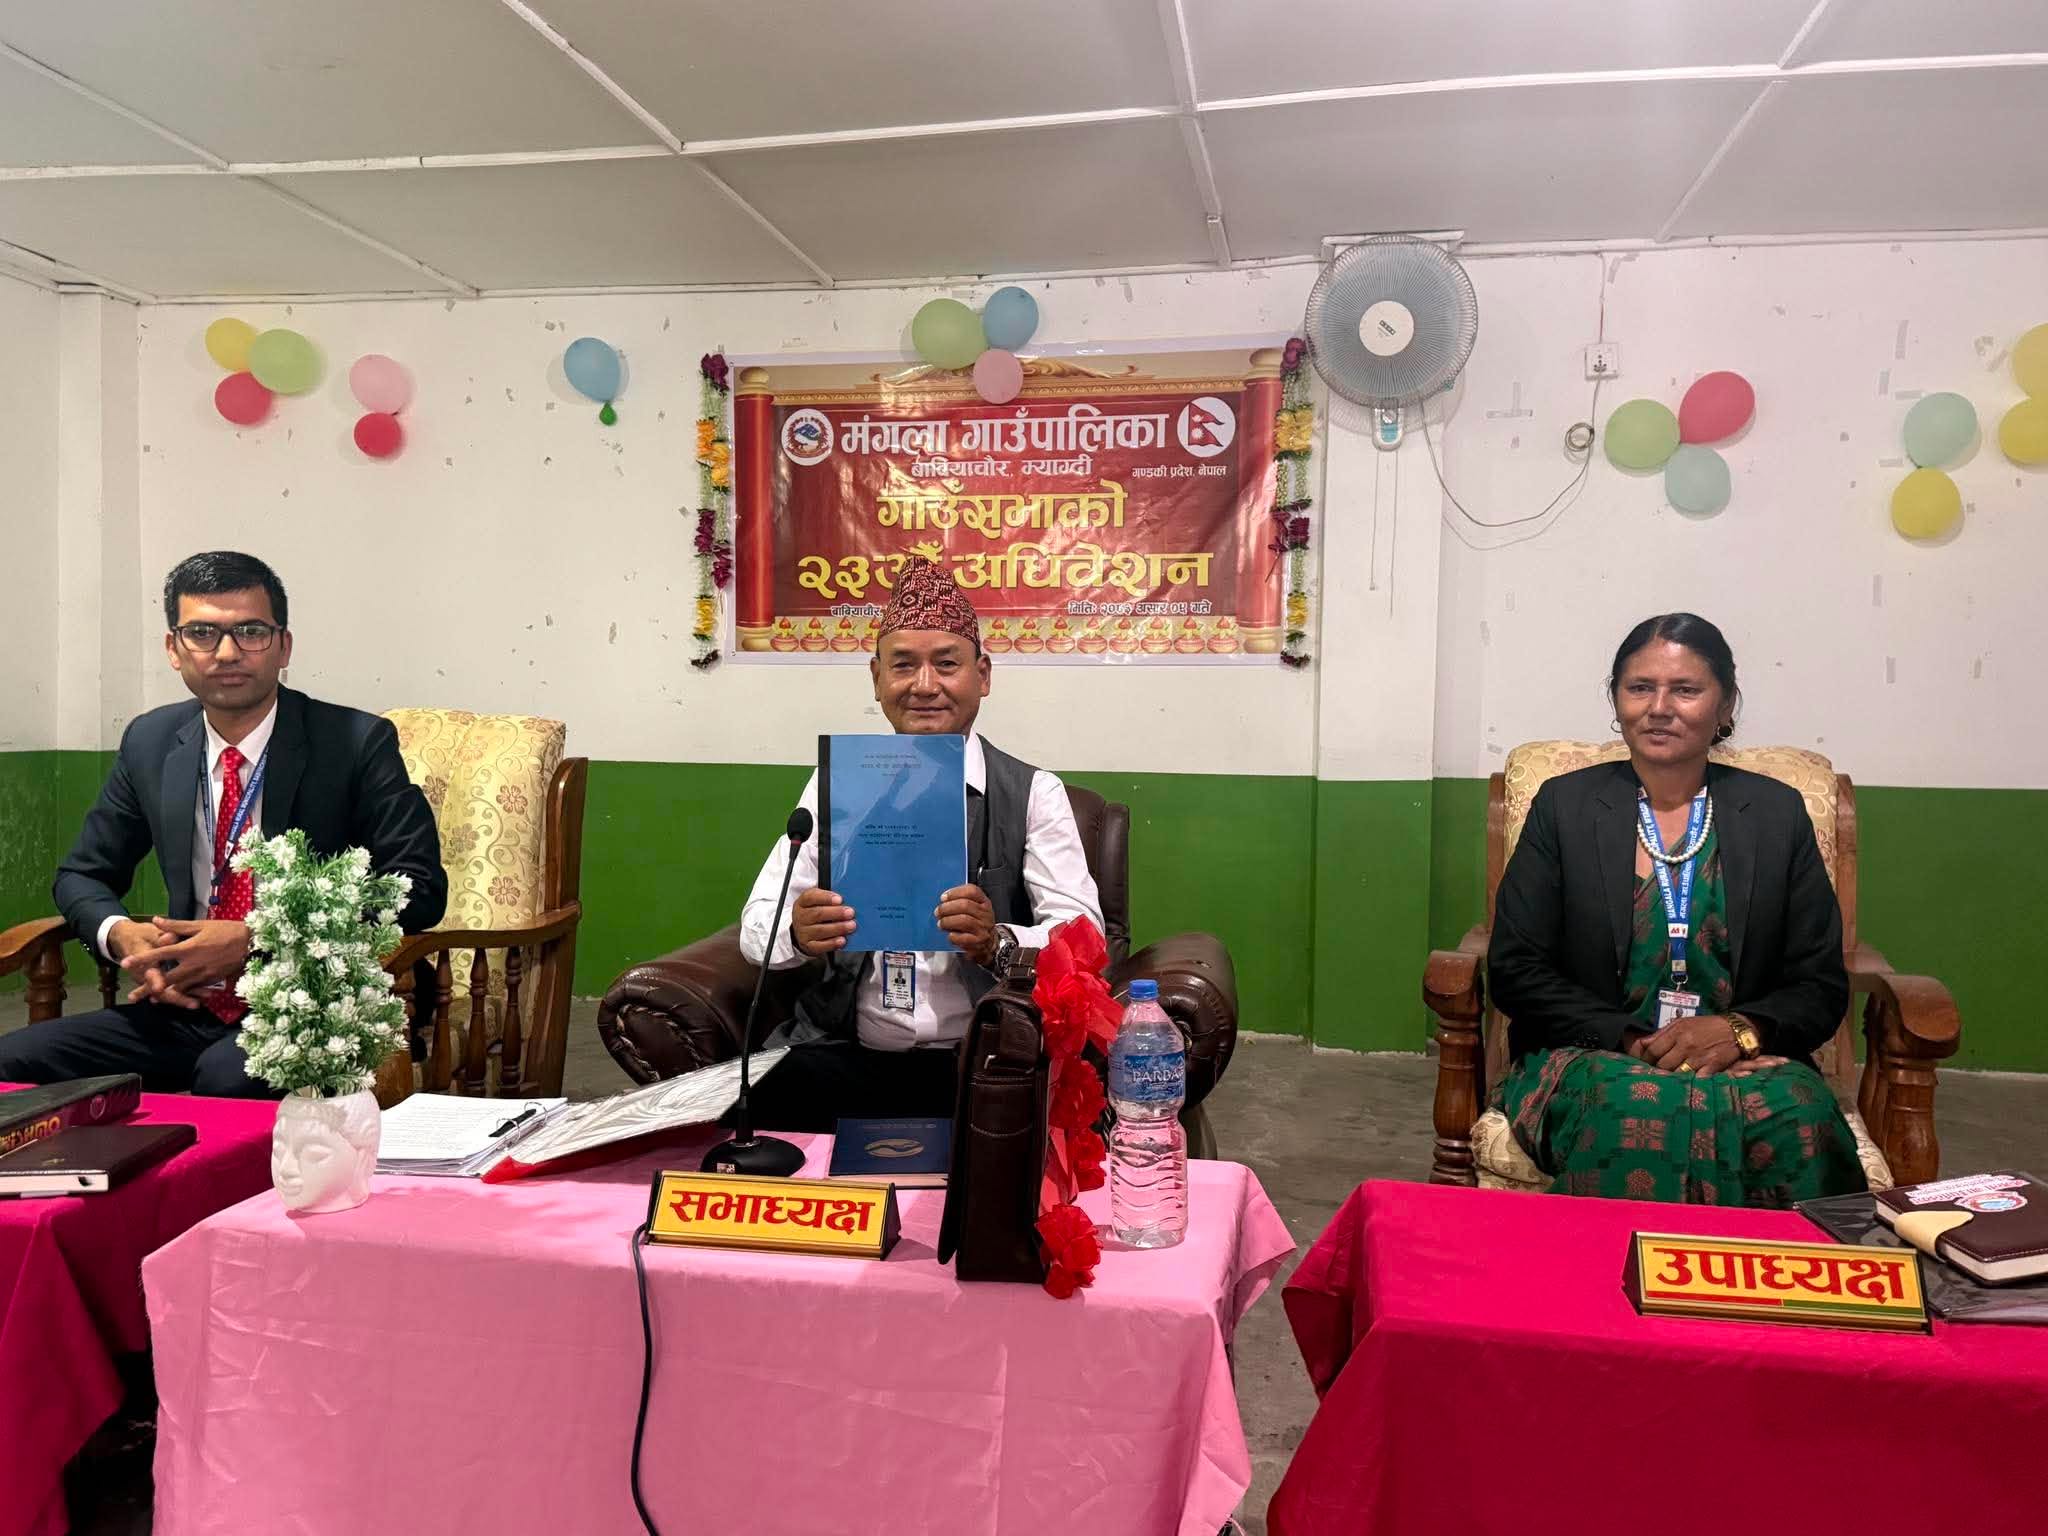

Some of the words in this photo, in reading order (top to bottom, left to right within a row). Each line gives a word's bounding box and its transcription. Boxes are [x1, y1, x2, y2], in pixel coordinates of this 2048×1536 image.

[840, 414, 950, 456] मंगला
[961, 403, 1170, 453] गाउँपालिका
[1021, 453, 1094, 476] म्याग्दी
[1132, 465, 1168, 479] गण्डकी
[1198, 464, 1227, 477] नेपाल
[877, 479, 1129, 539] गाउँसभाको
[952, 540, 1214, 597] अधिवेशन
[1135, 601, 1168, 615] असार
[1663, 887, 1677, 918] MANGALA
[669, 1189, 876, 1236] सभाध्यक्ष
[1653, 1248, 1906, 1304] उपाध्यक्ष
